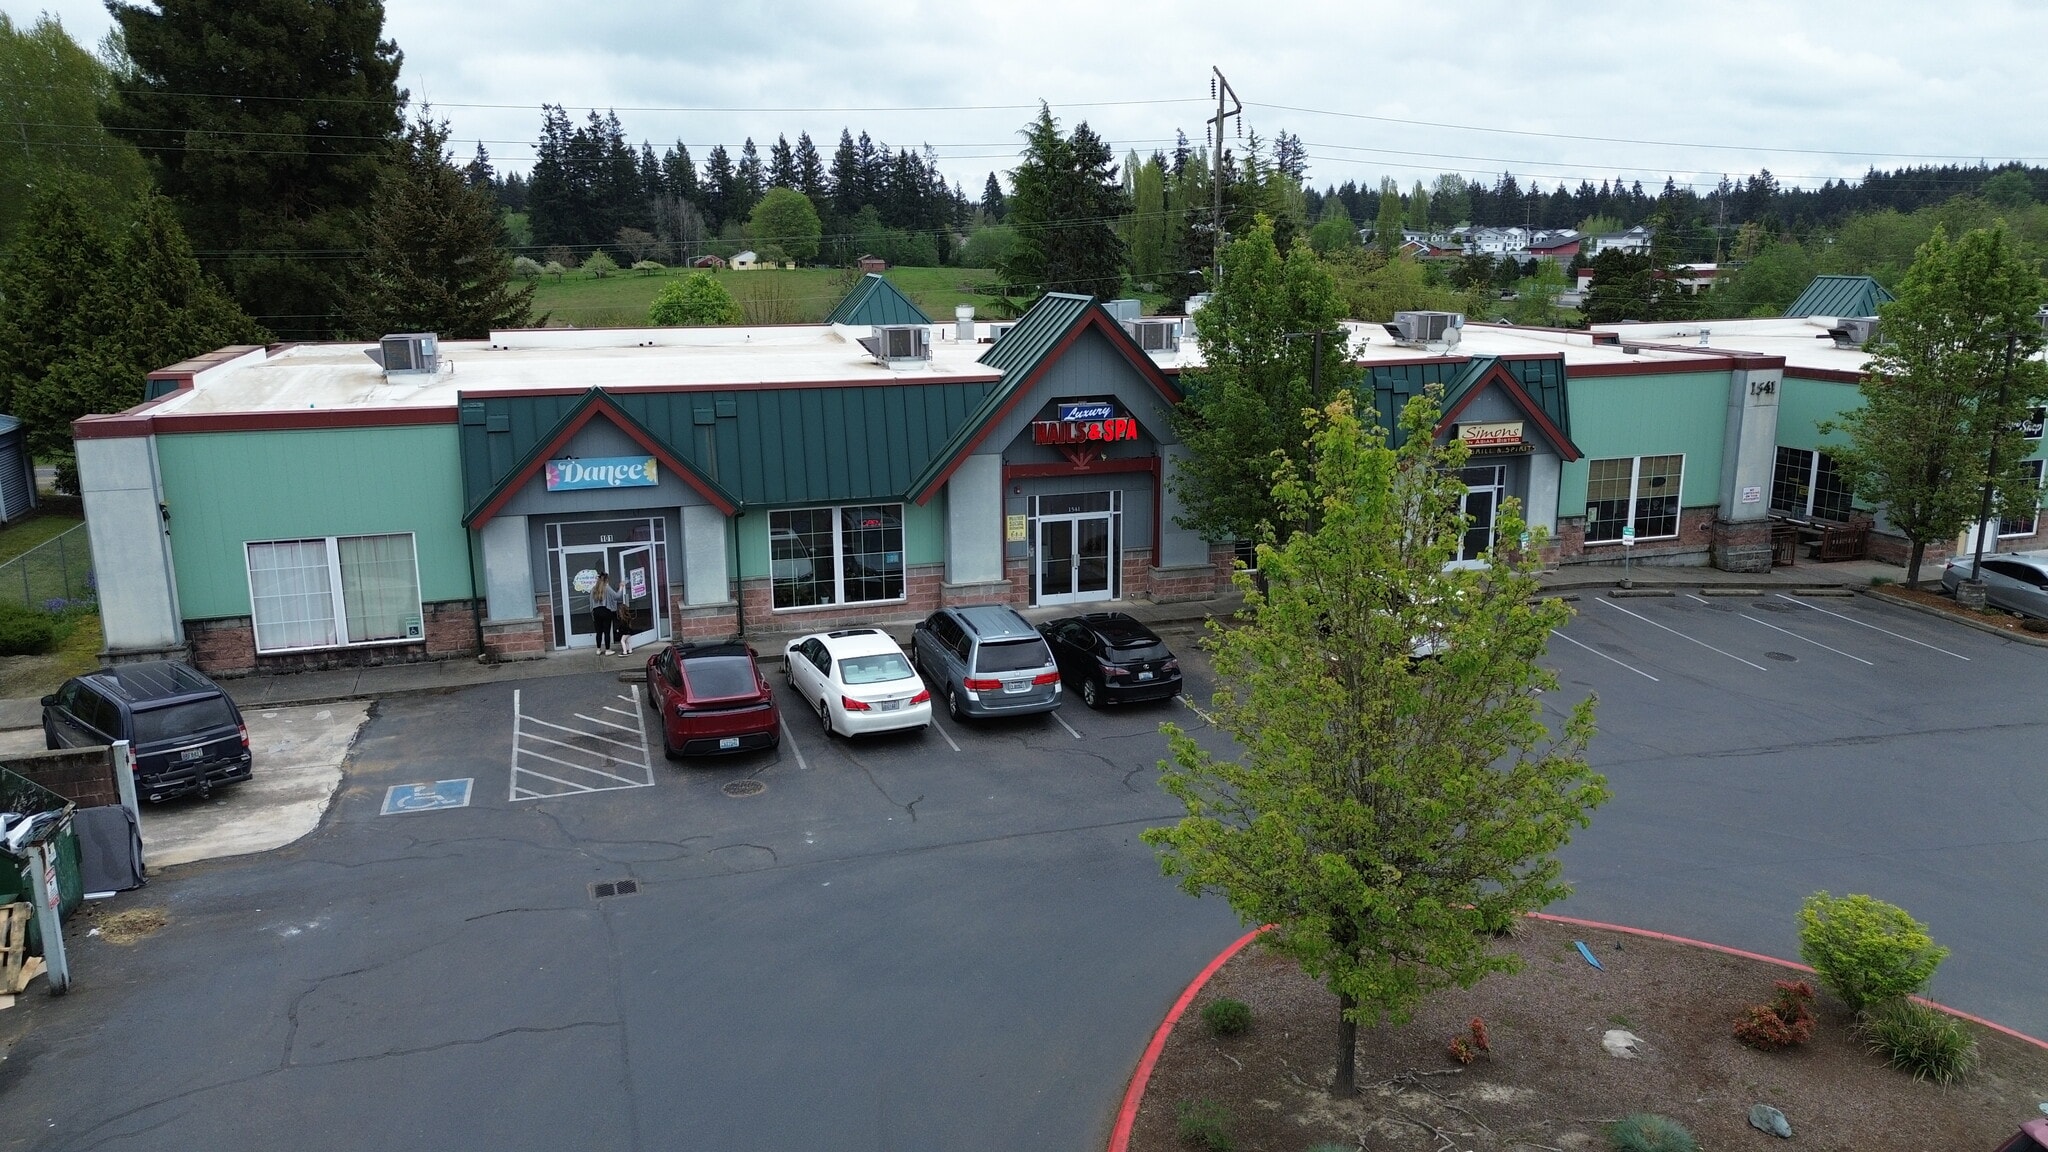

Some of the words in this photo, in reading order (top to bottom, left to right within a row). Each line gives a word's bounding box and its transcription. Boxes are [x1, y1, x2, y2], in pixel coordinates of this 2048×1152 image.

[1750, 380, 1776, 395] 1541
[1064, 407, 1112, 420] Luxury
[1462, 426, 1519, 439] Simons
[557, 459, 643, 486] Dance
